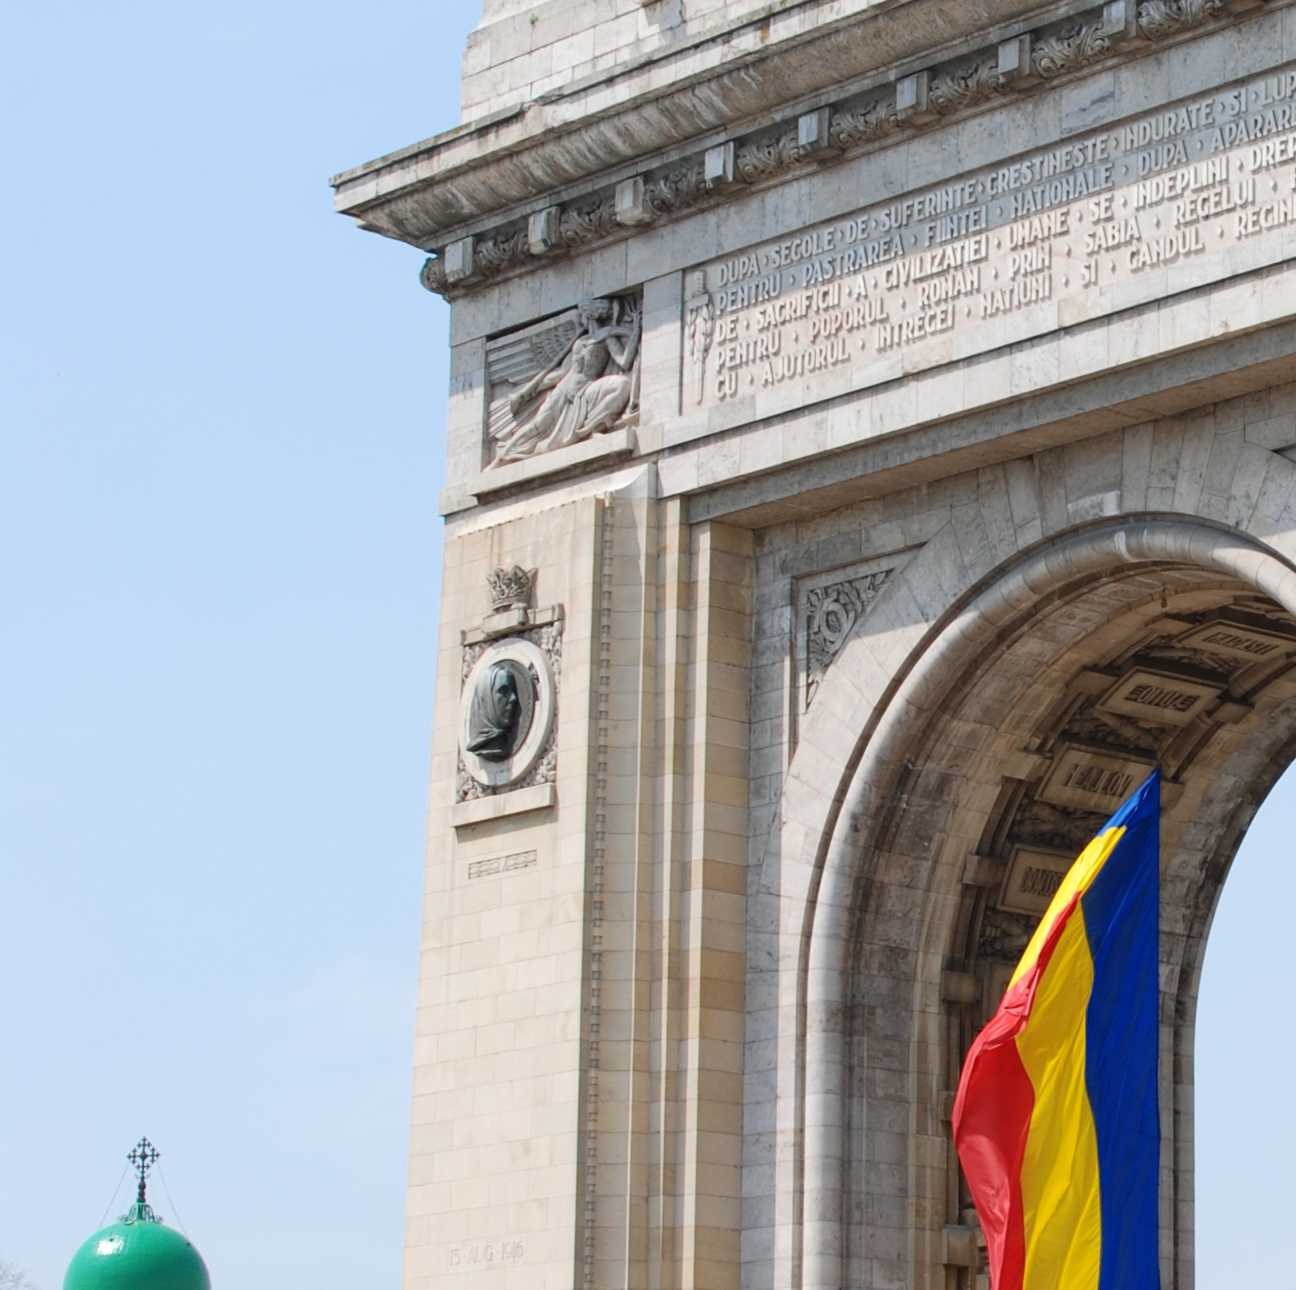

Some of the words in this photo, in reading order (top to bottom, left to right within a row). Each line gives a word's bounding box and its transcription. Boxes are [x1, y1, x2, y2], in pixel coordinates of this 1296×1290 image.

[716, 272, 783, 315] PENTRU
[802, 235, 904, 287] PASTRAREA
[924, 204, 988, 247] FIINTEI
[1010, 163, 1114, 219] NATIONALE
[1137, 140, 1189, 177] DUPA
[716, 317, 738, 344] DE
[755, 283, 842, 333] SACRIFICII
[855, 275, 868, 300] A
[882, 233, 988, 289] CIVILIZATIEI
[1007, 207, 1070, 250] UMANE
[1089, 193, 1115, 225] SE
[1134, 156, 1230, 209] INDEPLINI
[716, 331, 781, 374] PENTRU
[810, 299, 888, 343] POPORUL
[919, 266, 980, 308] ROMAN
[1008, 244, 1052, 279] PRIN
[1083, 215, 1142, 254] SABIA
[1172, 179, 1256, 227] REGELUI
[718, 259, 760, 288] DUPA
[770, 227, 835, 269] SECOLE
[846, 215, 869, 243] DE
[880, 179, 978, 231] SUFERINTE
[987, 135, 1110, 196] CRESTINESTE
[1121, 98, 1214, 153] INDURATE
[1230, 87, 1248, 115] SI
[715, 370, 738, 400] CU
[761, 338, 850, 387] AJUTORUL
[875, 305, 956, 351] INTREGEI
[980, 275, 1052, 320] NATIUNI
[1079, 259, 1100, 287] SI
[1126, 227, 1205, 274] GANDUL
[450, 1249, 460, 1267] 15
[467, 1245, 493, 1264] AUG
[502, 1241, 524, 1260] 1916
